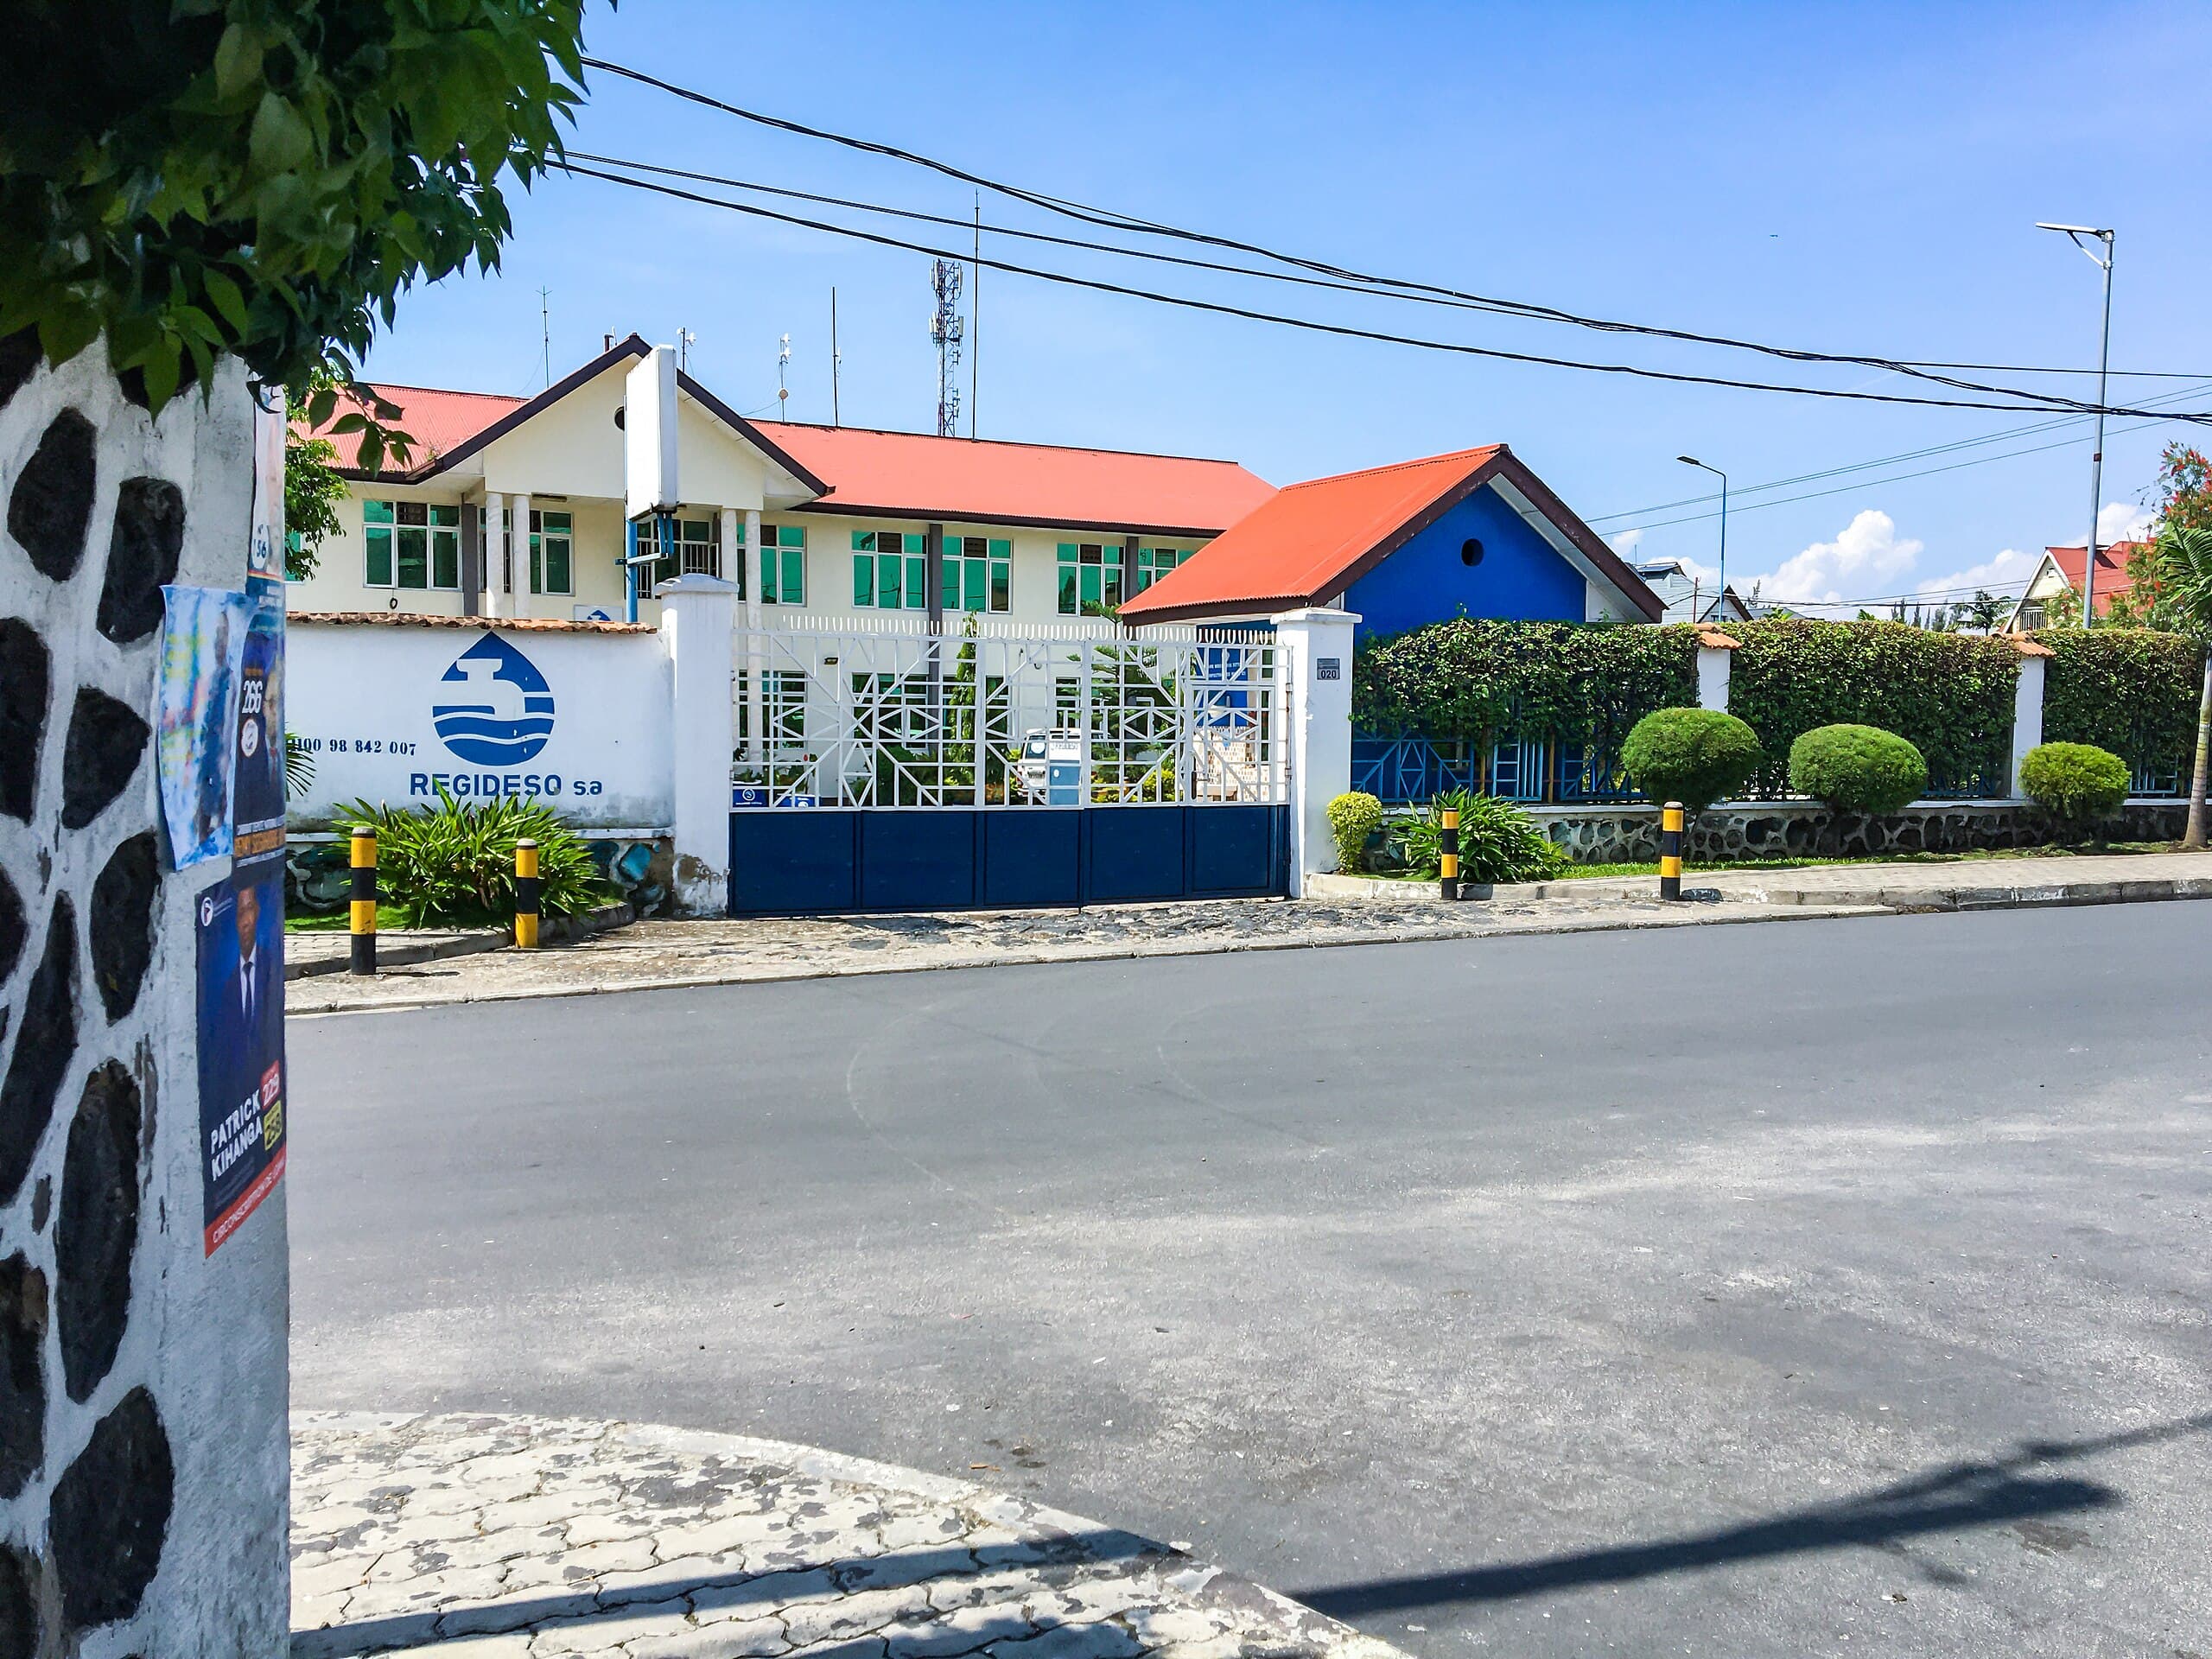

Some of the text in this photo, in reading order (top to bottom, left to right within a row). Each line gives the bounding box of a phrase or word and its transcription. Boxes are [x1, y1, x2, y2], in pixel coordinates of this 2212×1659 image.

[1320, 670, 1337, 679] 020
[242, 680, 263, 714] 266
[329, 739, 347, 753] 98
[355, 740, 382, 753] 842
[389, 741, 416, 756] 007
[410, 772, 562, 797] REGIDESO
[211, 1089, 261, 1154] PATRICK
[212, 1116, 263, 1182] KIHANGA
